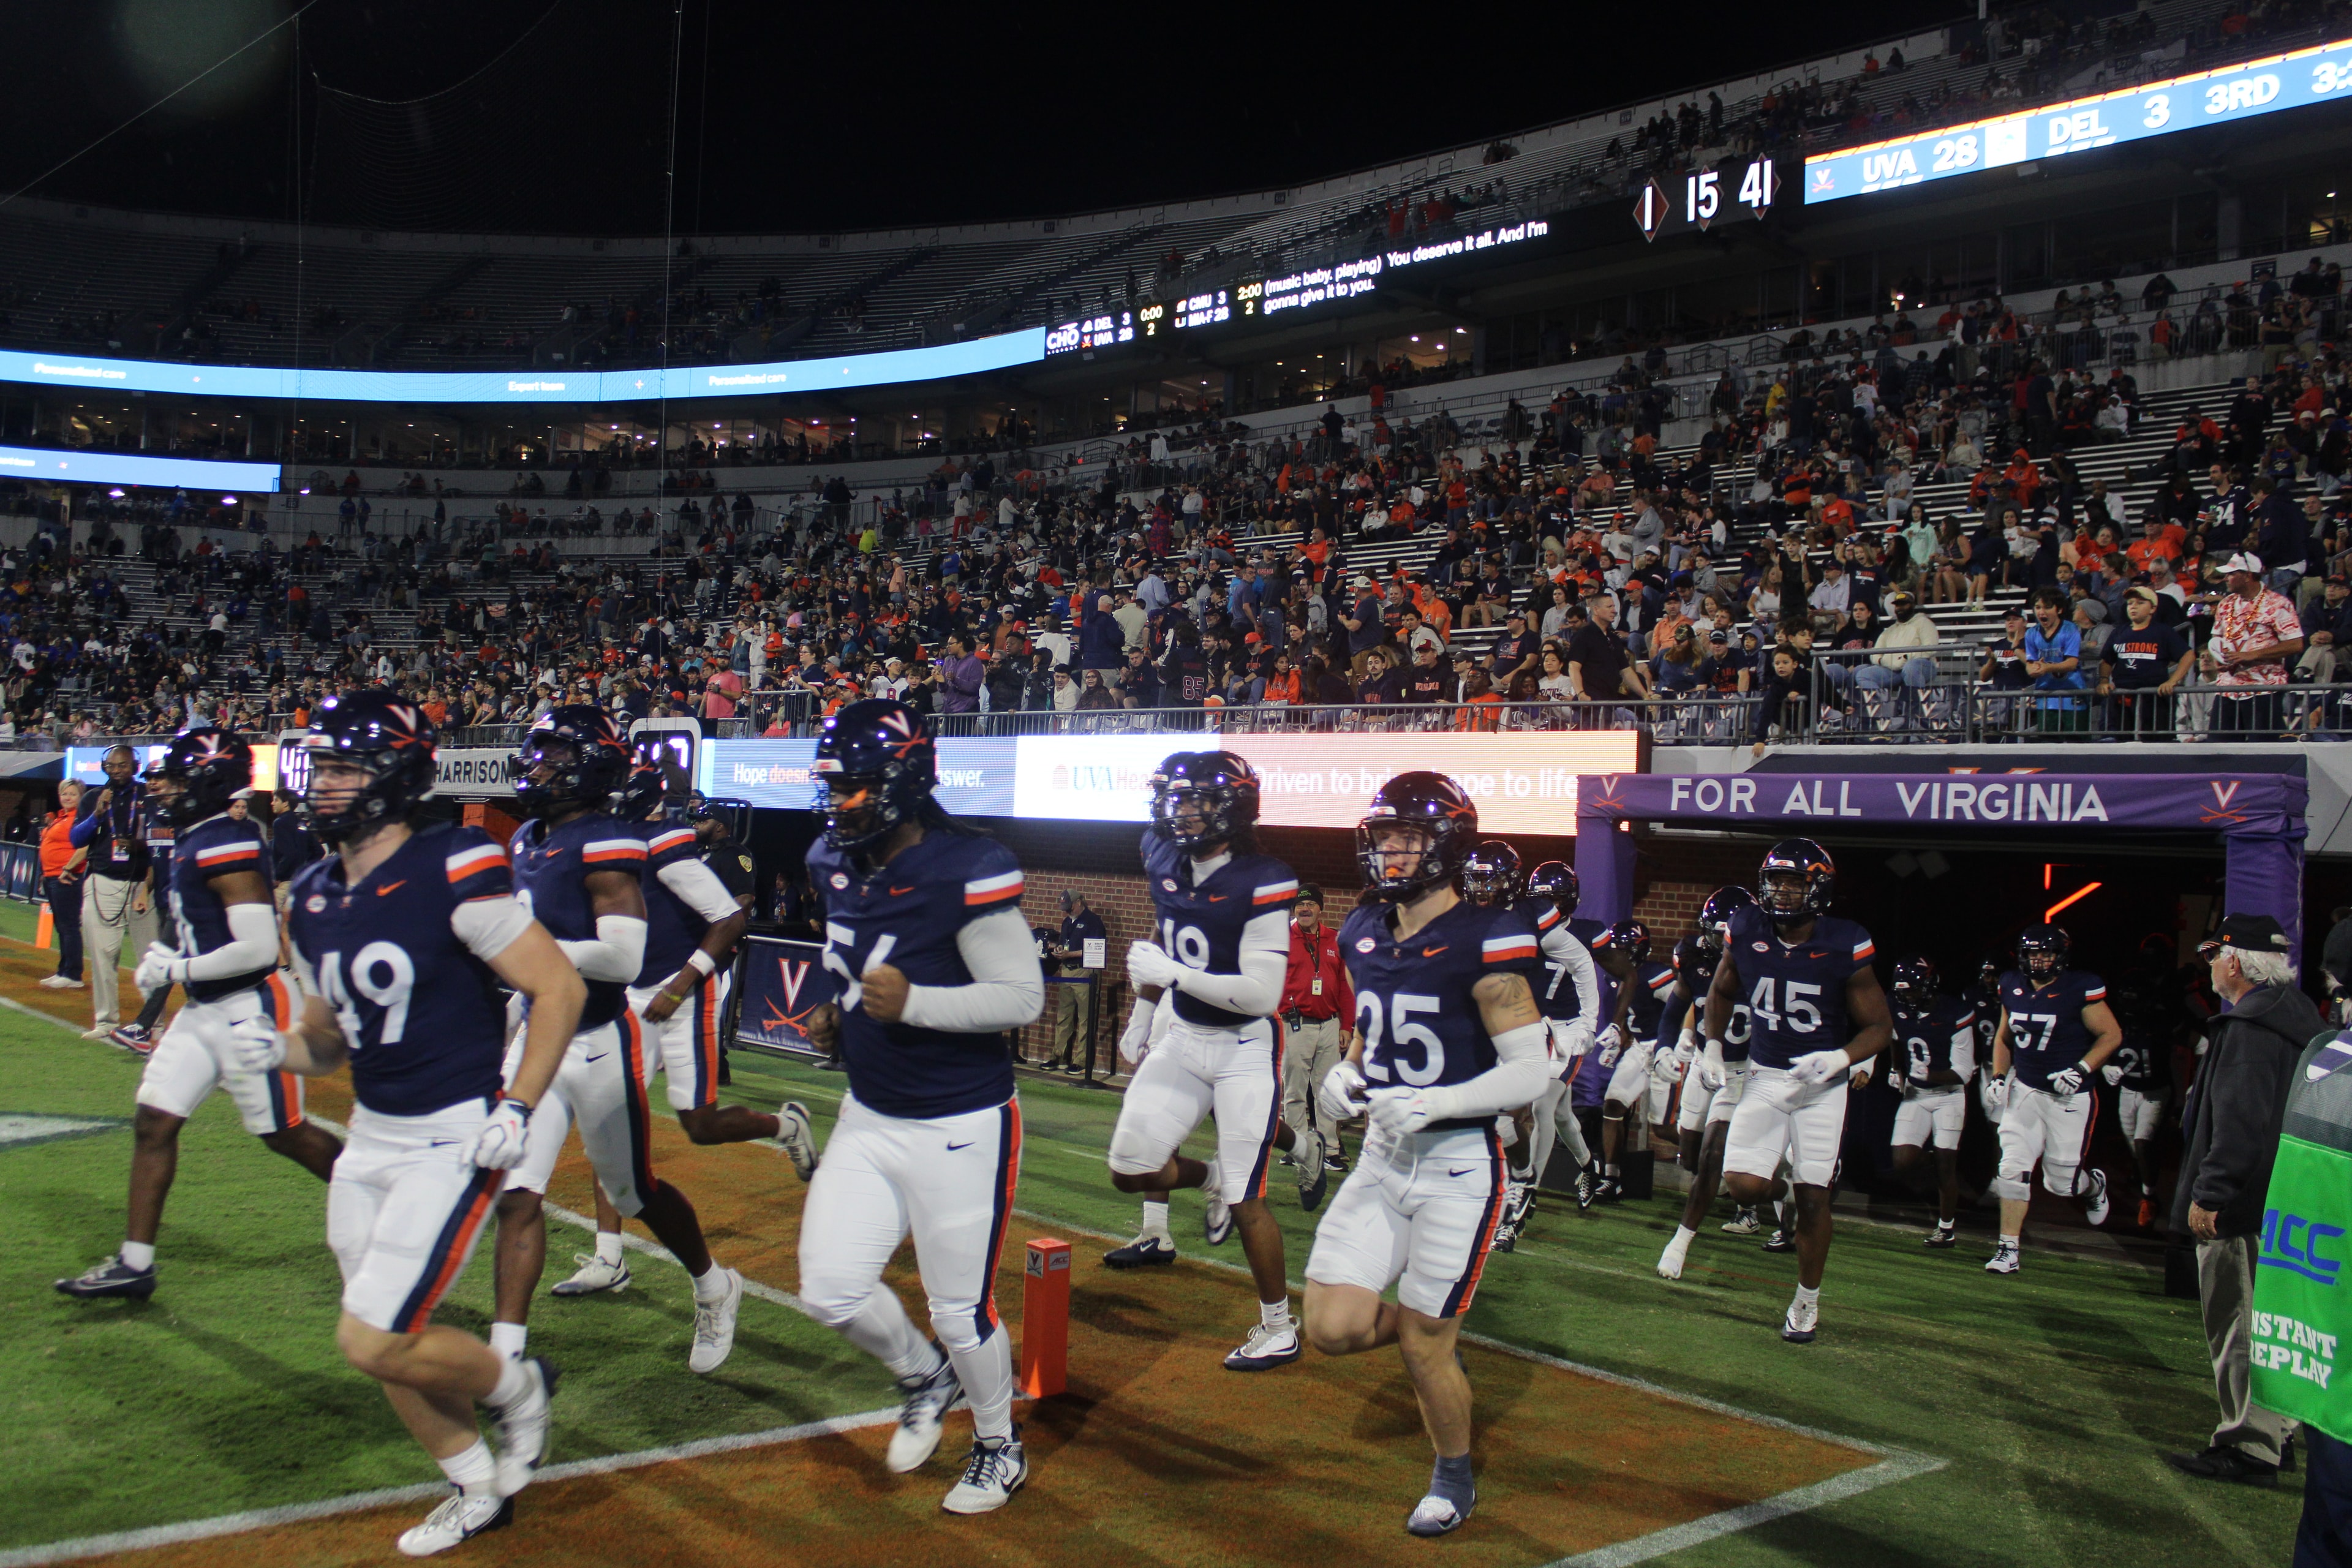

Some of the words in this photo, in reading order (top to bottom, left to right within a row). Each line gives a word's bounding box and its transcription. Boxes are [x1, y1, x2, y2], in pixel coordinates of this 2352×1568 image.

[1863, 149, 1918, 183] UVA
[1932, 135, 1978, 172] 28
[2049, 109, 2109, 146] DEL
[2143, 94, 2171, 129] 3
[2204, 74, 2280, 115] 3RD
[1687, 172, 1719, 222] 15
[1738, 159, 1772, 208] 41
[1265, 274, 1302, 298] (music
[1335, 255, 1382, 282] playing)
[1387, 251, 1411, 268] You
[1412, 239, 1463, 262] deserve
[1464, 235, 1474, 251] it
[1476, 230, 1496, 249] all.
[1497, 223, 1525, 244] And
[1527, 221, 1548, 238] I'm
[1188, 292, 1212, 311] CMU
[1218, 290, 1226, 305] 3
[1237, 282, 1262, 301] 2:00
[1264, 293, 1299, 315] gonna
[1300, 288, 1325, 307] give
[1327, 284, 1335, 299] it
[1336, 283, 1349, 297] to
[1349, 278, 1375, 298] you.
[1095, 315, 1114, 331] DEL
[1122, 312, 1131, 326] 3
[1140, 305, 1163, 322] 0:00
[1213, 306, 1229, 322] 28
[1245, 301, 1254, 315] 2
[1047, 328, 1079, 350] CHO
[1094, 330, 1114, 347] UVA
[1118, 326, 1133, 342] 28
[1147, 323, 1155, 336] 2
[767, 374, 787, 383] care
[2212, 502, 2235, 527] 34
[1182, 676, 1205, 701] 85
[734, 763, 767, 787] Hope
[1330, 767, 1352, 793] to
[1504, 769, 1531, 797] to
[1539, 767, 1578, 797] life
[1671, 777, 1756, 813] FOR
[1782, 780, 1861, 817] ALL
[1896, 782, 2109, 822] VIRGINIA
[1751, 976, 1823, 1033] 45
[1356, 990, 1446, 1087] 25
[2008, 1011, 2057, 1052] 57
[1907, 1036, 1931, 1081] 0
[2118, 1047, 2152, 1079] 21
[2252, 1309, 2337, 1360] NSTANT
